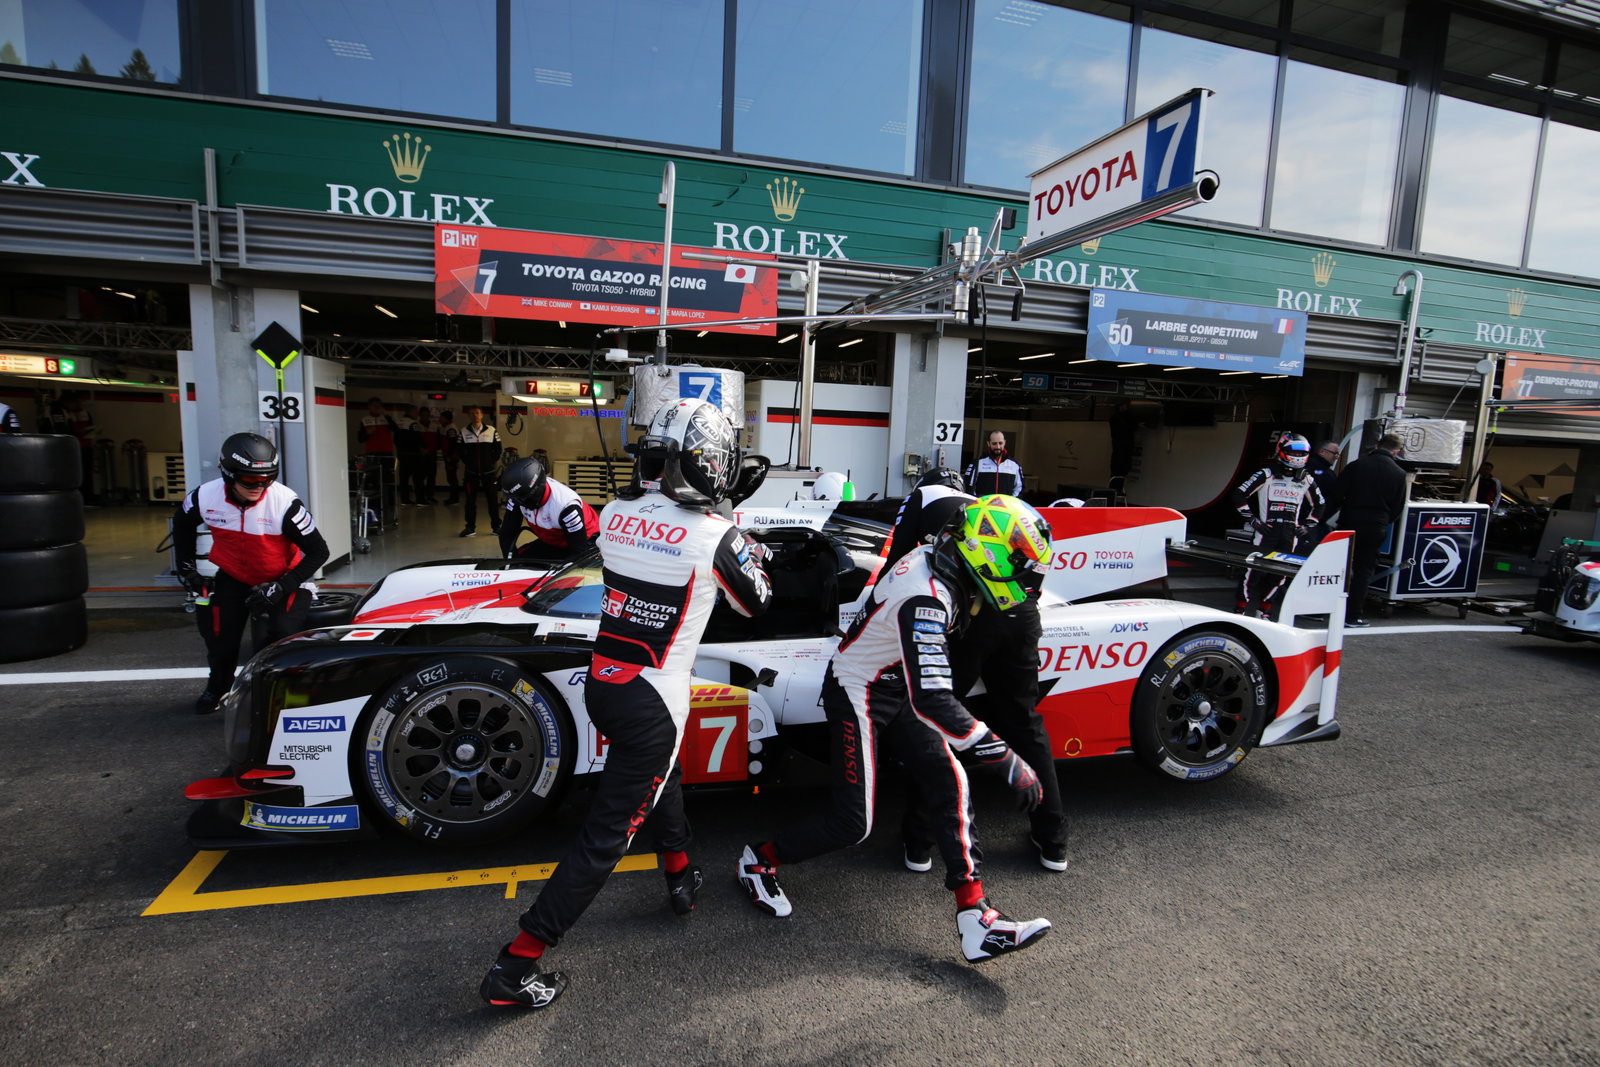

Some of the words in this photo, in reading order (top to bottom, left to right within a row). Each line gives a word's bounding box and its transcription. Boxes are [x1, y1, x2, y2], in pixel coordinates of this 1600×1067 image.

[1034, 150, 1138, 221] TOYOTA
[1155, 102, 1193, 193] 7
[325, 182, 498, 228] ROLEX
[461, 232, 479, 247] HY
[712, 221, 850, 262] ROLEX
[478, 268, 498, 295] 7
[521, 262, 586, 281] TOYOTA
[589, 269, 646, 286] GAZOO
[648, 274, 708, 291] RCING
[1031, 257, 1141, 293] ROLEX
[571, 282, 600, 293] TOYOTA
[629, 286, 657, 297] HYBRID
[533, 299, 548, 307] MIKE
[548, 301, 573, 309] CONWAY
[591, 303, 609, 312] KAMUI
[610, 305, 640, 314] KOBAYASHI
[1276, 288, 1363, 318] ROLEX
[671, 310, 688, 318] MARIA
[688, 311, 706, 319] LOPEZ
[1108, 323, 1133, 346] 50
[1145, 318, 1189, 334] LARBRE
[1191, 323, 1258, 340] COMPETITION
[1474, 322, 1548, 349] ROLEX
[46, 360, 58, 372] 8
[527, 382, 536, 392] 7
[581, 384, 589, 394] 7
[688, 376, 715, 401] 7
[1517, 378, 1534, 397] 77
[1534, 375, 1598, 390] DEMPSEY-PROTON
[261, 395, 301, 421] 38
[532, 407, 578, 417] TOYOTA
[579, 408, 625, 419] HYBRI
[935, 422, 962, 443] 37
[606, 513, 688, 545] DENSO
[768, 518, 796, 526] AISIN
[1430, 516, 1472, 526] LARBRE
[1020, 516, 1046, 552] DENSO
[604, 532, 636, 548] TOYOTA
[636, 538, 682, 558] HYBRID
[1094, 550, 1134, 560] TOYOTA
[1092, 561, 1134, 571] HYBRID
[451, 579, 492, 587] HYBRID
[492, 573, 501, 583] 7
[1307, 574, 1341, 588] JTEKT
[624, 602, 670, 622] GAZOO
[628, 595, 678, 615] TOYOTA
[917, 608, 946, 621] JTEKT
[622, 611, 666, 630] Racing
[1037, 640, 1149, 674] DENSO
[1150, 673, 1168, 689] RL
[287, 718, 341, 731] AISIN
[535, 702, 558, 756] MICHELIN
[283, 744, 333, 753] MITSUBISHI
[699, 715, 737, 774] 7
[842, 719, 859, 785] DENSO
[279, 752, 321, 761] ELECTRIC
[368, 752, 395, 808] MICHELIN
[266, 812, 348, 826] MICHELIN
[422, 820, 444, 840] FL
